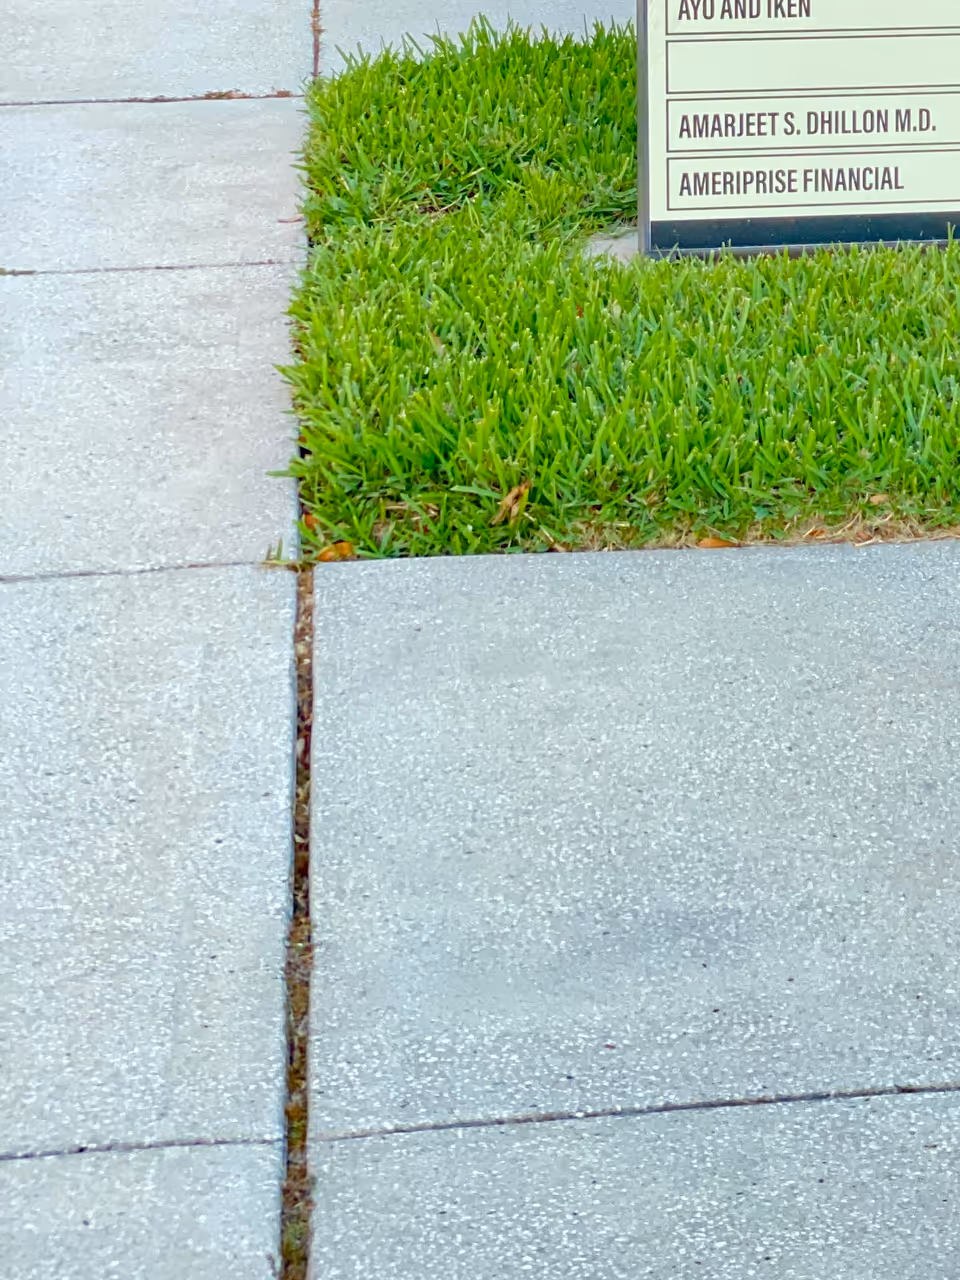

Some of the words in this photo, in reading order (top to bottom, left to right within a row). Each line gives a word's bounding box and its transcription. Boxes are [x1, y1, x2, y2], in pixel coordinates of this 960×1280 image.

[679, 112, 780, 138] AMARJEET
[784, 111, 801, 135] S.
[807, 109, 889, 135] DHILLON
[895, 109, 937, 133] M.D.
[679, 170, 798, 197] AMERIPRISE
[803, 166, 904, 192] FINANCIAL
